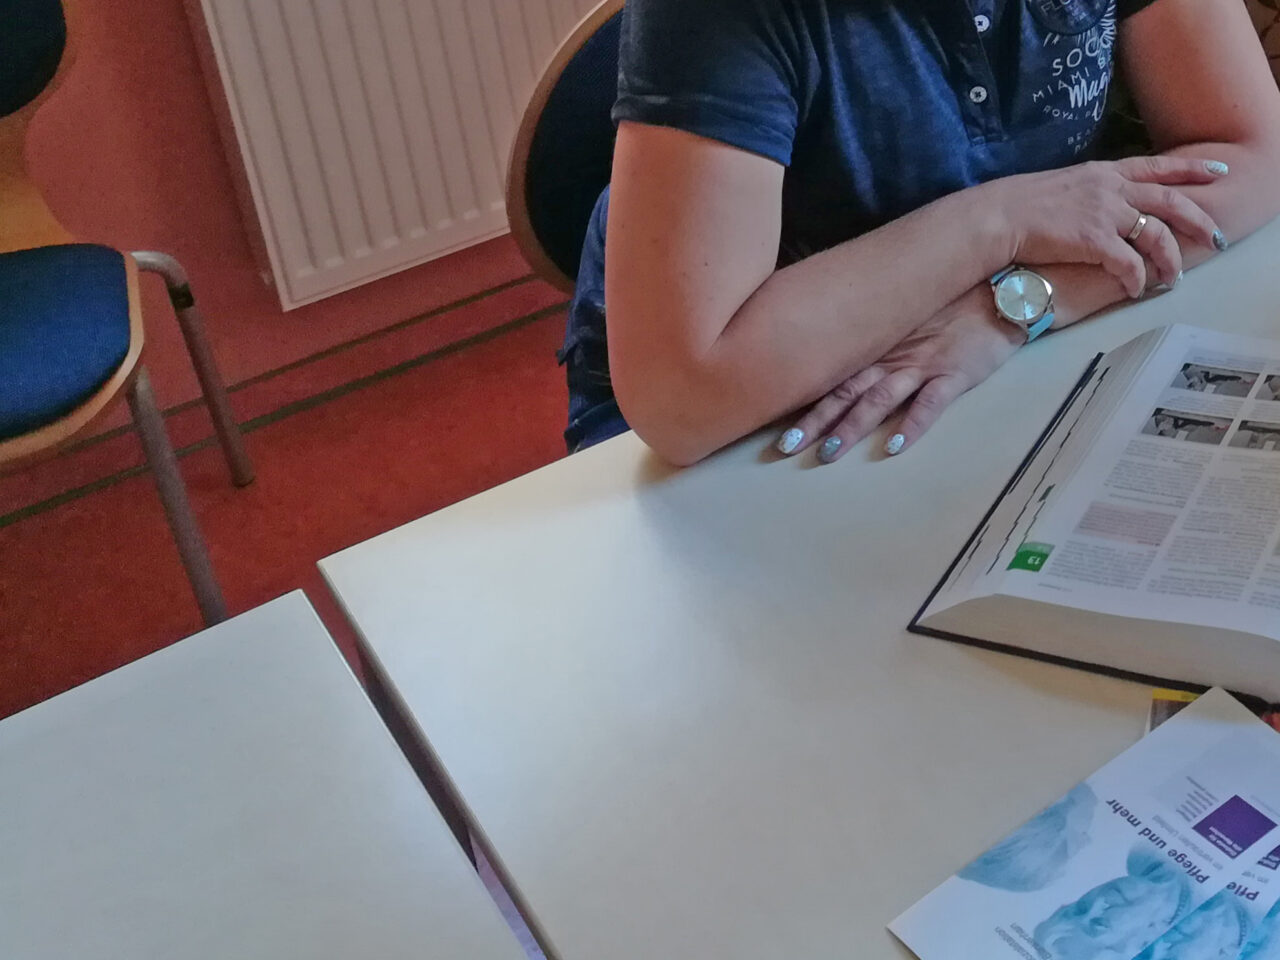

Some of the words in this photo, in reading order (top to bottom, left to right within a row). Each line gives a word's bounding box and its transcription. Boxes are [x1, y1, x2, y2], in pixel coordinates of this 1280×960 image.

[1033, 66, 1090, 103] MIAMI
[1105, 799, 1142, 827] mehr
[1138, 827, 1167, 849] und
[1167, 848, 1210, 884] Pflege
[1226, 881, 1260, 901] Pfle
